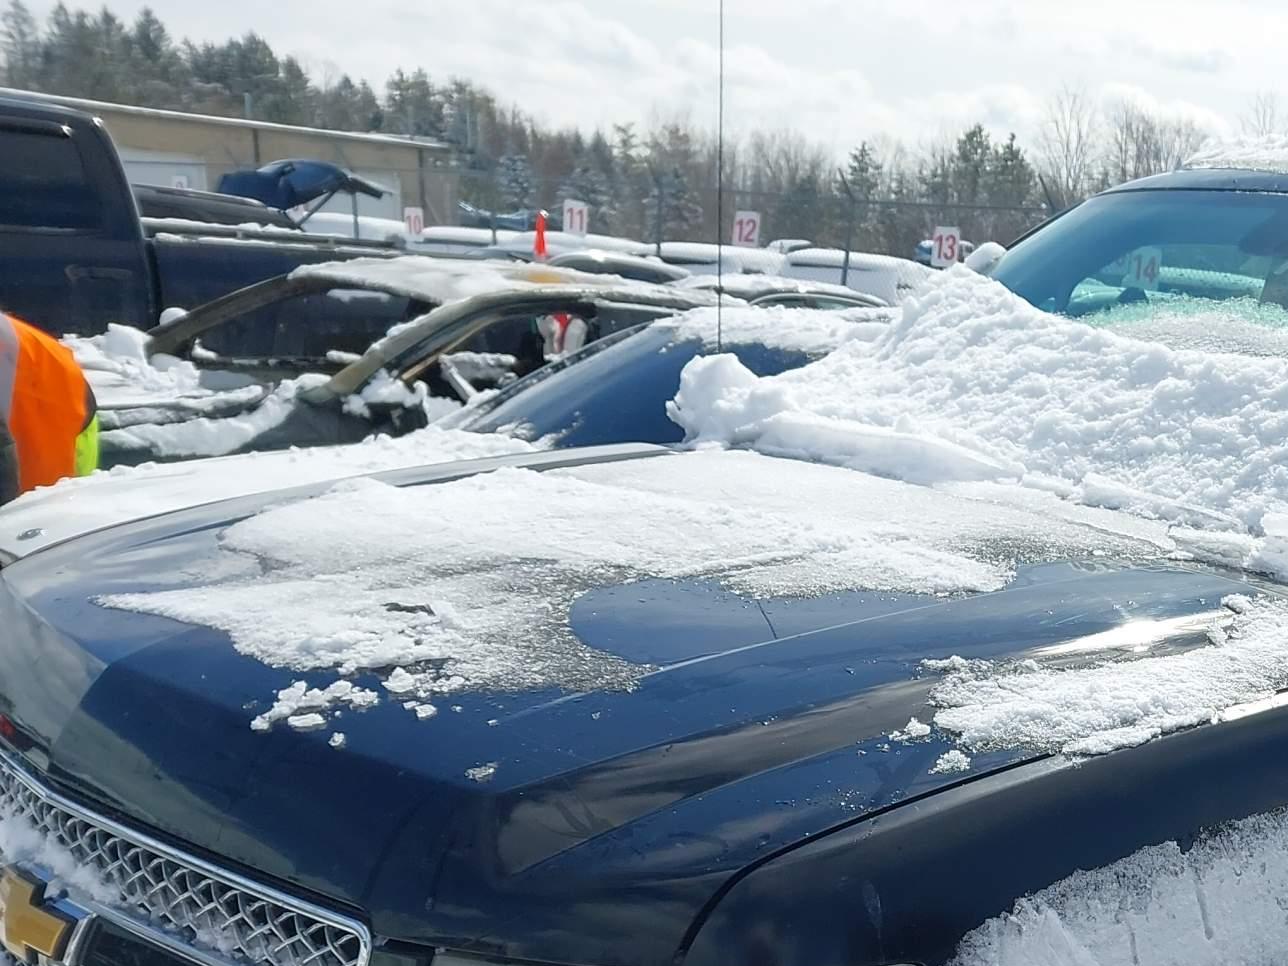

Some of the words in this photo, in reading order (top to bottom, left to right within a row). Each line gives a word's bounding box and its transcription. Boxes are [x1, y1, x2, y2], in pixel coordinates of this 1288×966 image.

[406, 215, 422, 234] 10
[567, 207, 584, 231] 11
[736, 218, 756, 242] 12
[935, 234, 956, 260] 13
[1134, 254, 1156, 283] 14
